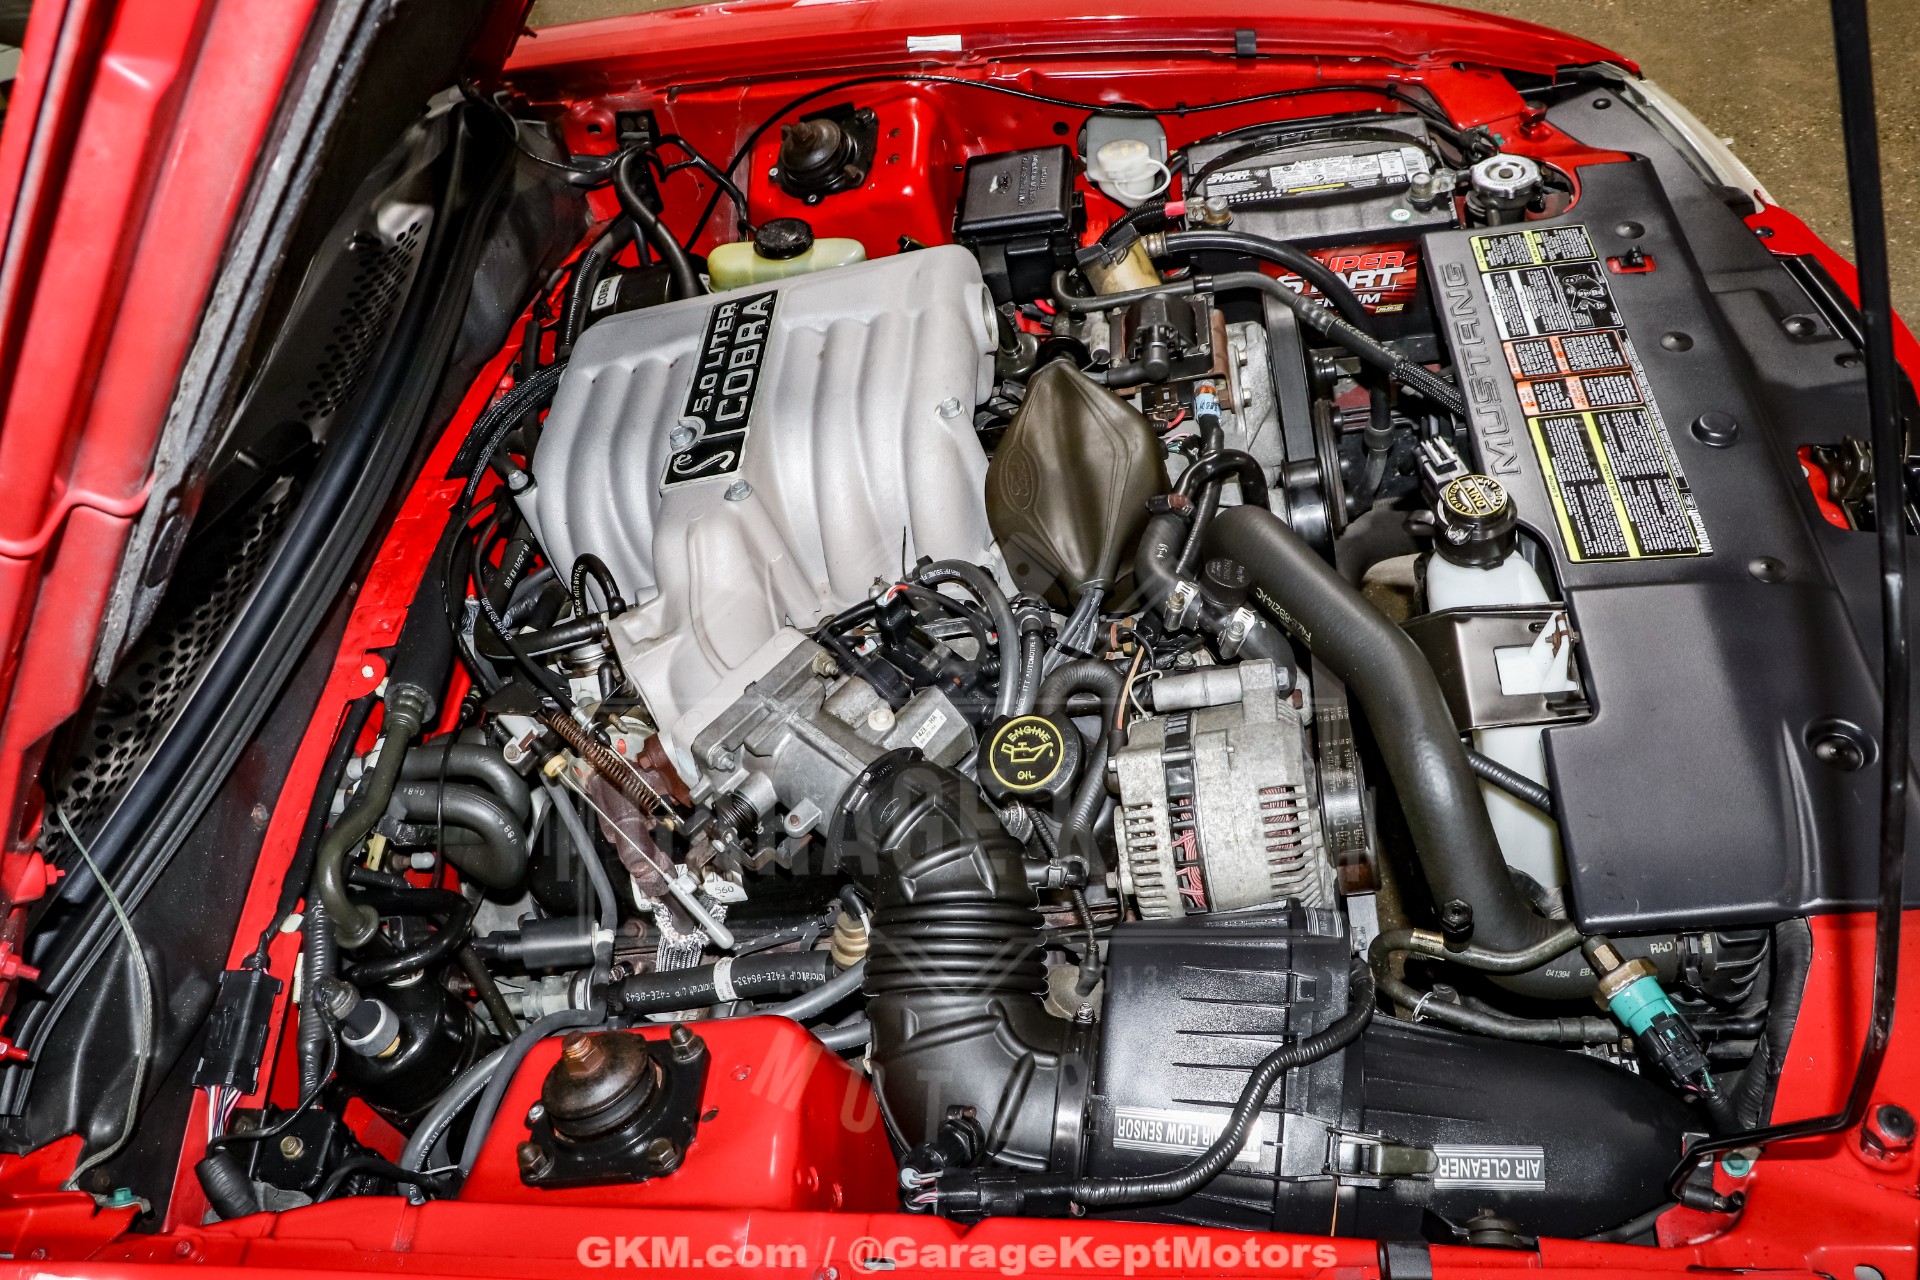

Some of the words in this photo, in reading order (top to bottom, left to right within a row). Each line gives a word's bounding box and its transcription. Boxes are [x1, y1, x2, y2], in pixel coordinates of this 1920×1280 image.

[1312, 251, 1405, 273] UPER
[1277, 267, 1402, 294] SART
[705, 301, 738, 369] LITER
[715, 293, 774, 422] COBRA
[1438, 261, 1522, 476] MUSTANG
[693, 373, 718, 413] 5.0
[1465, 484, 1487, 510] ONLY
[1686, 508, 1714, 554] Motorcraft
[1025, 641, 1037, 678] AUTOMOTIVE
[1006, 725, 1052, 743] ENGINE
[1017, 770, 1036, 780] OIL
[714, 885, 734, 894] 560
[1650, 941, 1673, 954] RAD
[1545, 968, 1571, 978] 041394
[1117, 1119, 1162, 1141] SENSOR
[1167, 1122, 1202, 1145] FLOW
[1438, 1157, 1511, 1178] CLEANER
[1514, 1158, 1541, 1179] AIR
